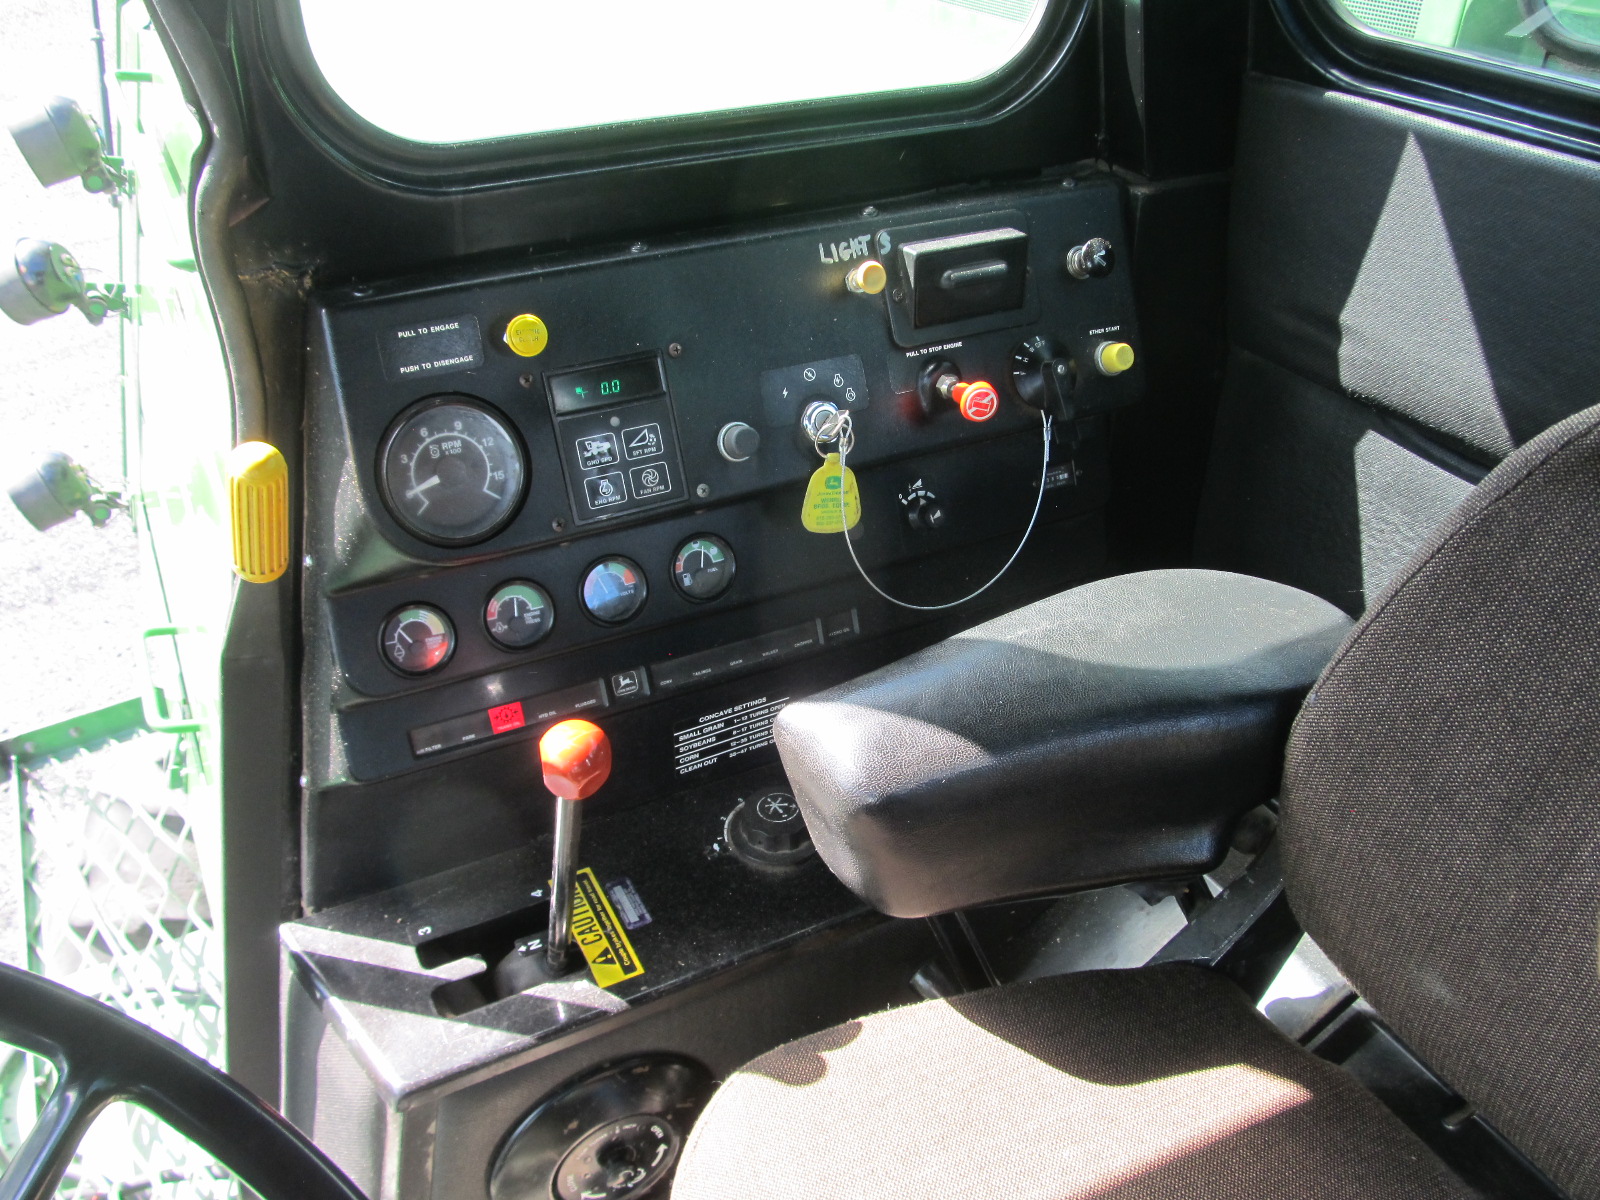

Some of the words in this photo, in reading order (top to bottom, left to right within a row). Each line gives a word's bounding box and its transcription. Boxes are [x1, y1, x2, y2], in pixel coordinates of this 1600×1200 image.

[397, 329, 416, 338] PULL
[418, 327, 428, 335] TO
[430, 322, 460, 333] ENGAGE
[1089, 328, 1105, 336] ETHER
[1105, 325, 1120, 333] START
[905, 350, 920, 358] PULL
[928, 345, 943, 354] STOP
[943, 341, 963, 351] ENGINE
[400, 365, 420, 374] PUSH
[421, 362, 431, 370] TO
[433, 354, 474, 368] DISENGAGE
[600, 379, 620, 395] 0.0
[454, 421, 462, 430] 9
[420, 427, 429, 437] 6
[441, 439, 462, 450] RPM
[482, 437, 495, 447] 12
[644, 446, 657, 454] RPM
[400, 454, 408, 464] 3
[586, 459, 600, 467] GND
[640, 487, 652, 495] FAN
[652, 484, 665, 492] RPM
[608, 494, 621, 503] RPM
[698, 707, 733, 723] CONCAVE
[733, 696, 767, 712] SETTINGS
[678, 730, 702, 742] SMALL
[702, 721, 725, 734] GRAIN
[749, 708, 769, 721] TURNS
[679, 736, 717, 753] SOYBEANS
[749, 719, 769, 732] TURNS
[679, 753, 700, 764] CORN
[749, 731, 769, 743] TURNS
[679, 762, 703, 775] CLEAN
[703, 757, 718, 767] OUT
[749, 740, 769, 752] TURNS
[530, 888, 544, 898] 4
[417, 925, 433, 937] 3
[617, 948, 631, 966] Couple
